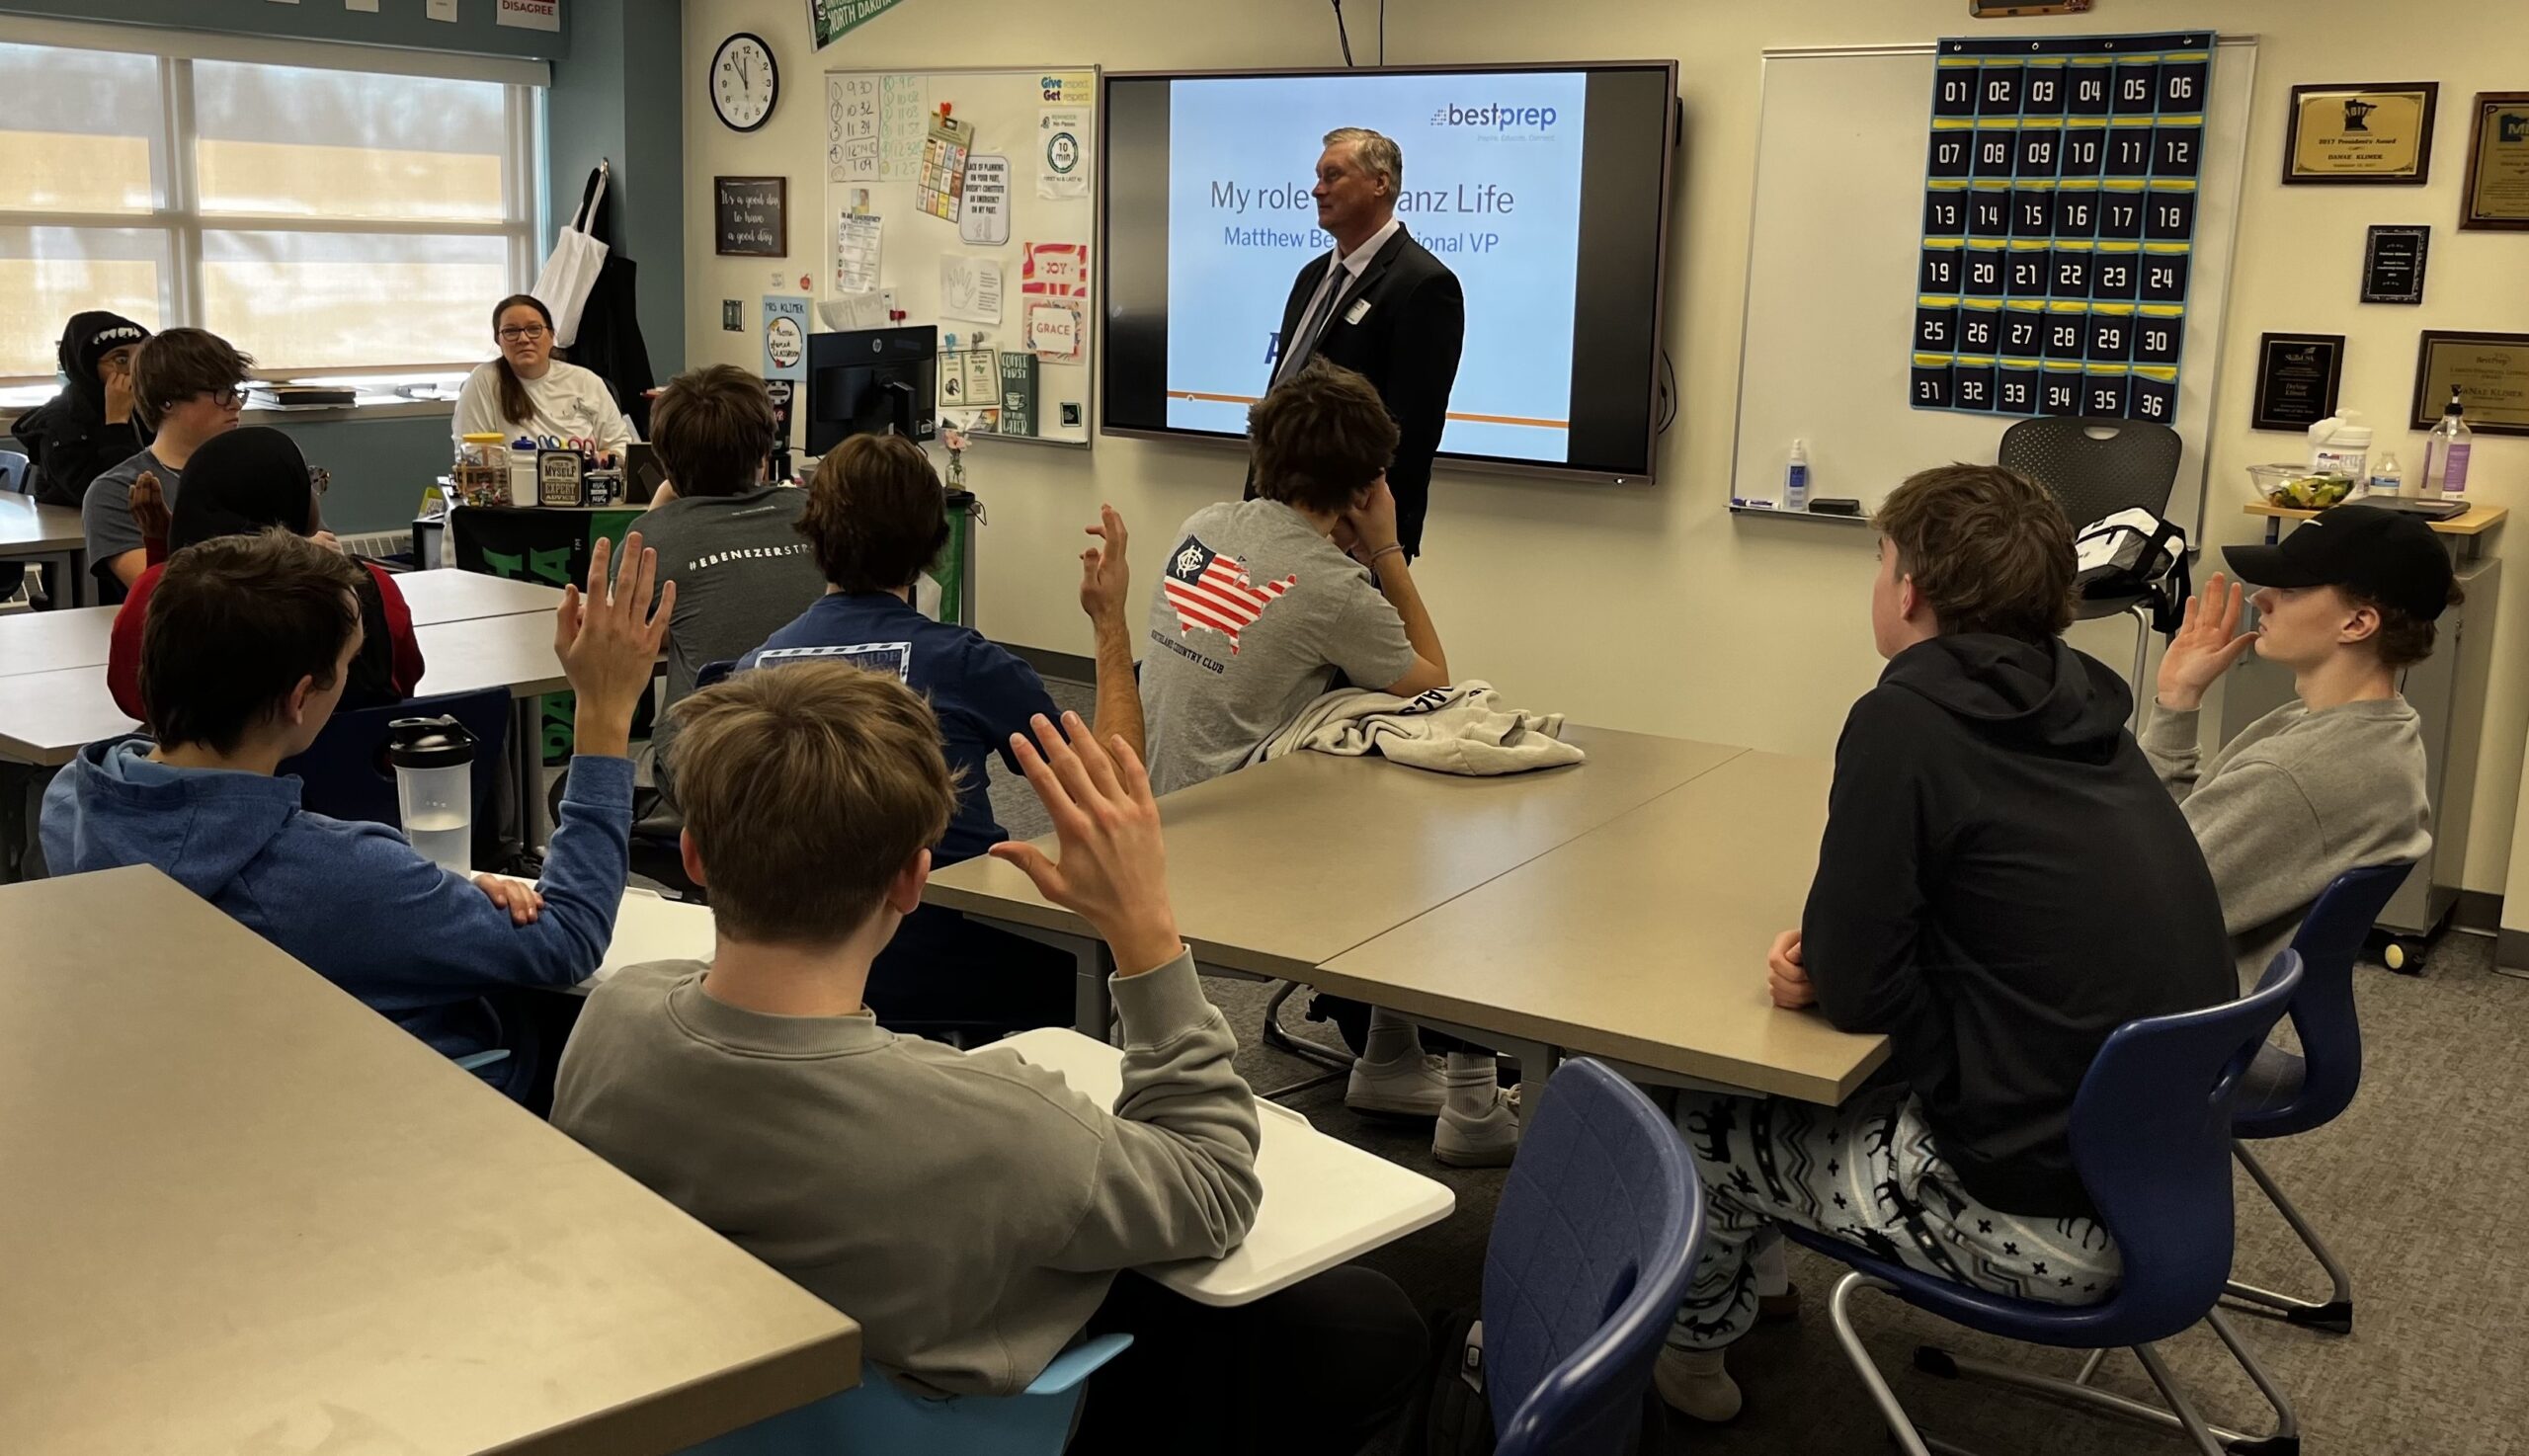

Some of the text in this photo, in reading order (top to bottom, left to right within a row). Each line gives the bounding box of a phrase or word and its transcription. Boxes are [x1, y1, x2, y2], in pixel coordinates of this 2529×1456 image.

[502, 0, 554, 16] DISAGREE
[828, 0, 893, 35] NORTH DAKO
[743, 45, 751, 54] 12
[723, 62, 731, 71] 10
[763, 62, 769, 71] 2
[1040, 76, 1062, 89] Give
[1944, 76, 2192, 102] 01 02 03 04 05 06
[1043, 90, 1060, 101] Get
[1448, 103, 1557, 131] bestprep
[1058, 142, 1068, 152] 10
[1938, 141, 2188, 164] 07 08 09 10 11 12
[736, 196, 744, 204] a
[745, 193, 765, 208] good
[766, 193, 780, 209] day
[1211, 181, 1514, 214] My role anz Life
[734, 210, 765, 223] to have
[1935, 204, 2180, 228] 13 14 15 16 17 18
[727, 228, 773, 246] a good day
[1225, 226, 1499, 253] Matthew Be ional VP
[1046, 262, 1068, 275] JOY
[1929, 262, 2173, 288] 19 20 21 22 23 24
[1036, 322, 1071, 336] GRACE
[1923, 321, 2167, 352] 25 26 27 28 29 30
[1002, 355, 1027, 368] COFFEE
[1002, 367, 1027, 379] FIRST
[1919, 381, 2163, 417] 31 32 33 34 35 36
[1003, 418, 1028, 435] LATER
[544, 464, 577, 477] MYSELF
[545, 482, 576, 494] EXPERT
[689, 543, 814, 571] #EBENEZERSTR
[1173, 641, 1203, 664] COUNTRY
[1201, 657, 1224, 675] CLUB
